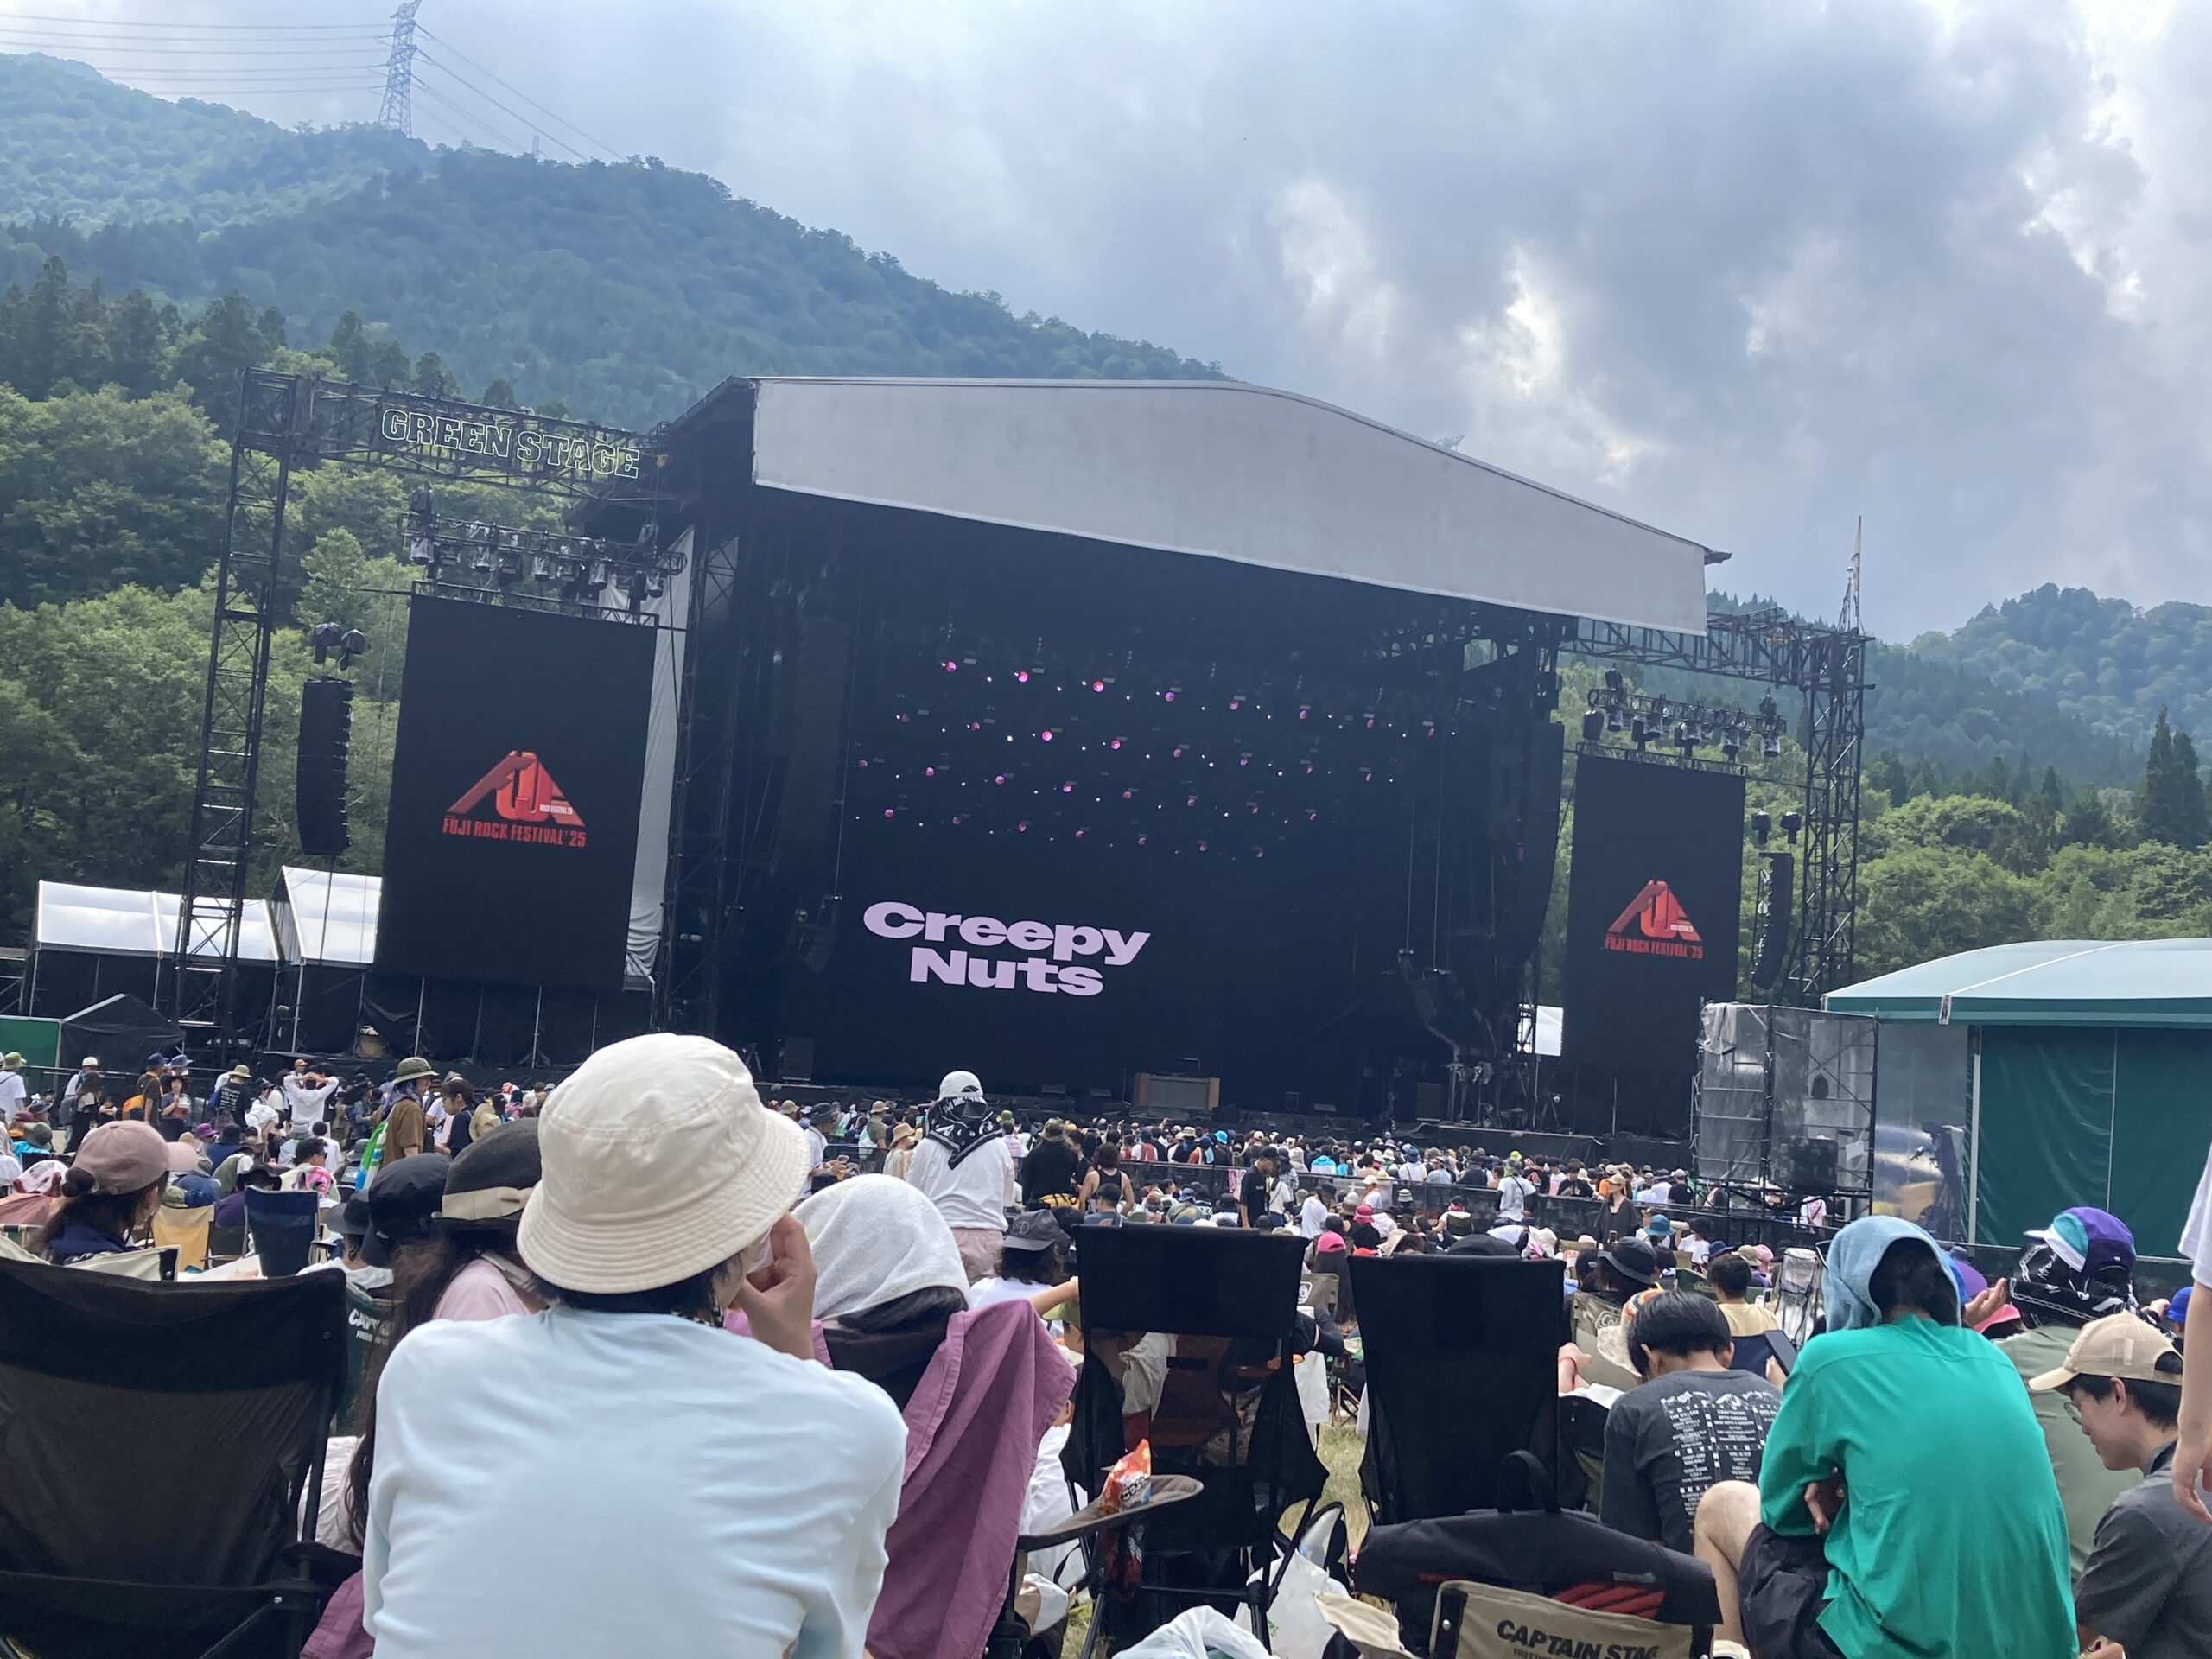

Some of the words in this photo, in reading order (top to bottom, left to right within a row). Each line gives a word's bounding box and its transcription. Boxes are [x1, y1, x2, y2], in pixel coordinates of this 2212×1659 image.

[381, 409, 512, 458] GREEN
[517, 431, 640, 479] STAGE
[442, 817, 471, 836] FUJI
[474, 821, 508, 840] ROCK
[511, 823, 563, 845] FESTIVAL
[863, 901, 1151, 966] Creepy
[1605, 936, 1625, 950] FUJI
[1626, 938, 1649, 953] ROCK
[1652, 942, 1688, 957] FESTIVAL
[910, 946, 1103, 996] Nuts
[1497, 1619, 1601, 1659] CAPTAIN
